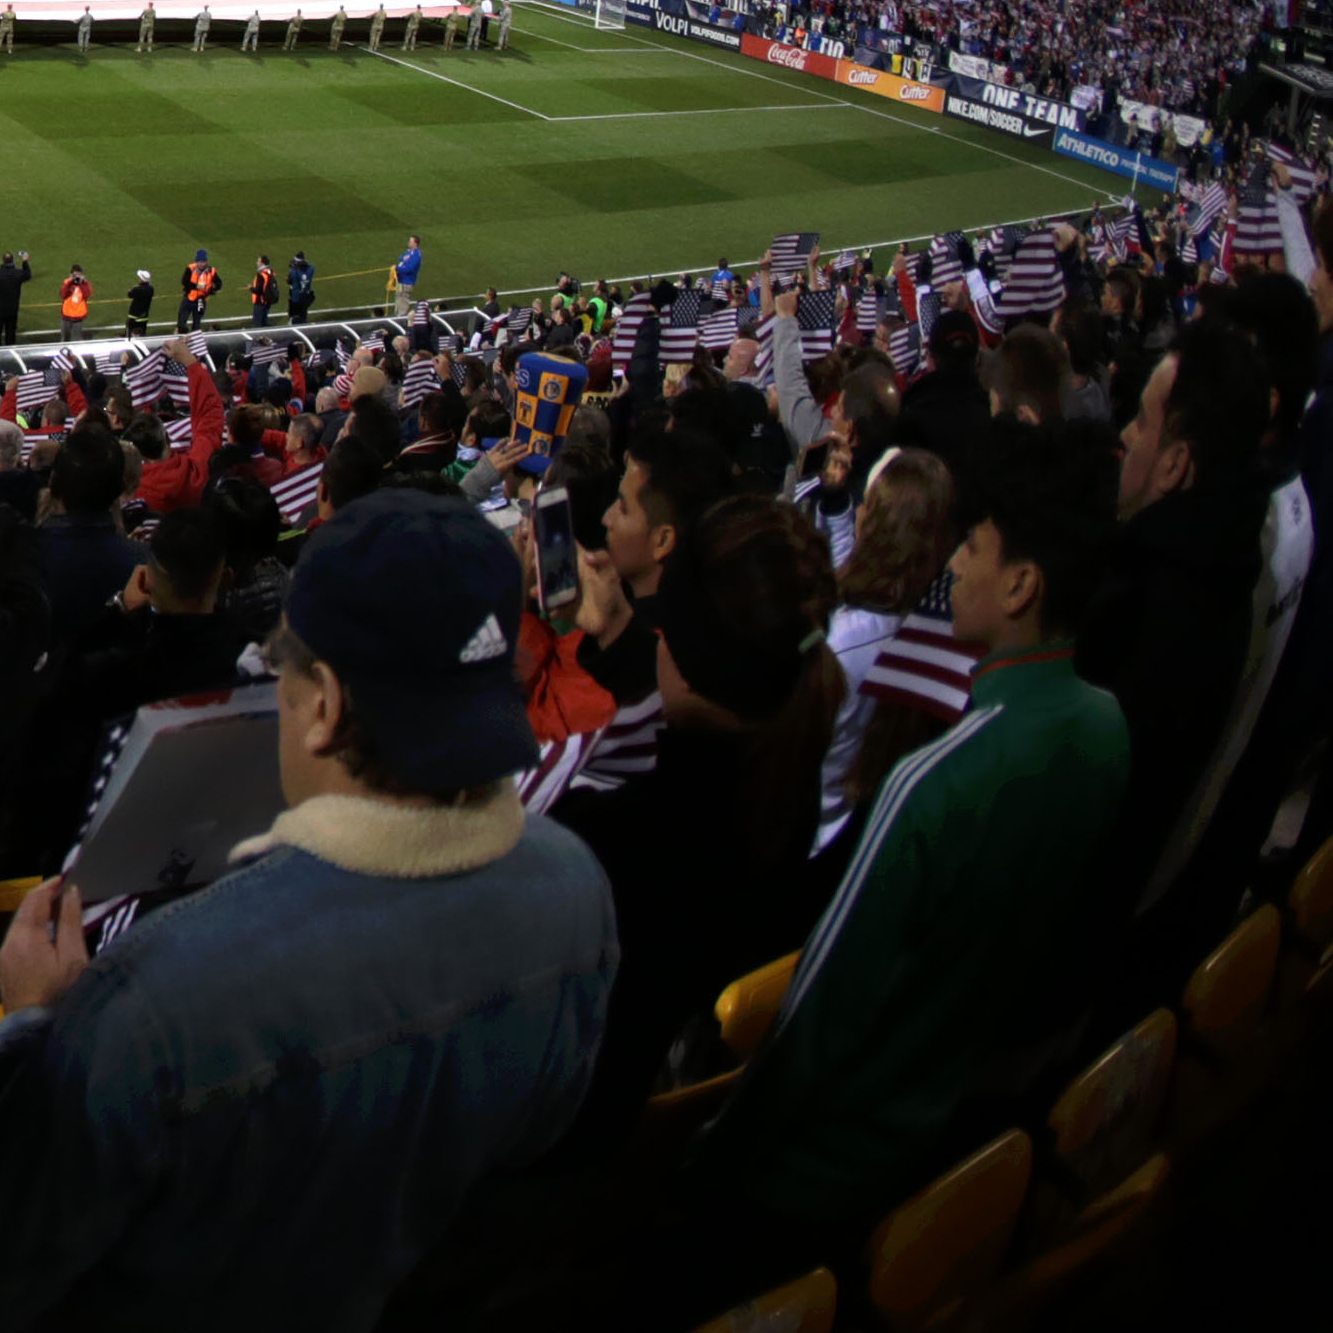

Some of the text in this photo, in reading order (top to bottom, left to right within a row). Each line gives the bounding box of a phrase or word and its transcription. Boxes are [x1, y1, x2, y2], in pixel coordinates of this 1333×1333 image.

[655, 11, 689, 36] VOLPI
[848, 68, 878, 84] Cutter
[899, 84, 931, 100] Cutter
[947, 96, 1024, 135] NIKE.COM/SOCCER
[983, 84, 1080, 132] ONE TEAM.
[1057, 133, 1120, 167] ATHLETICO
